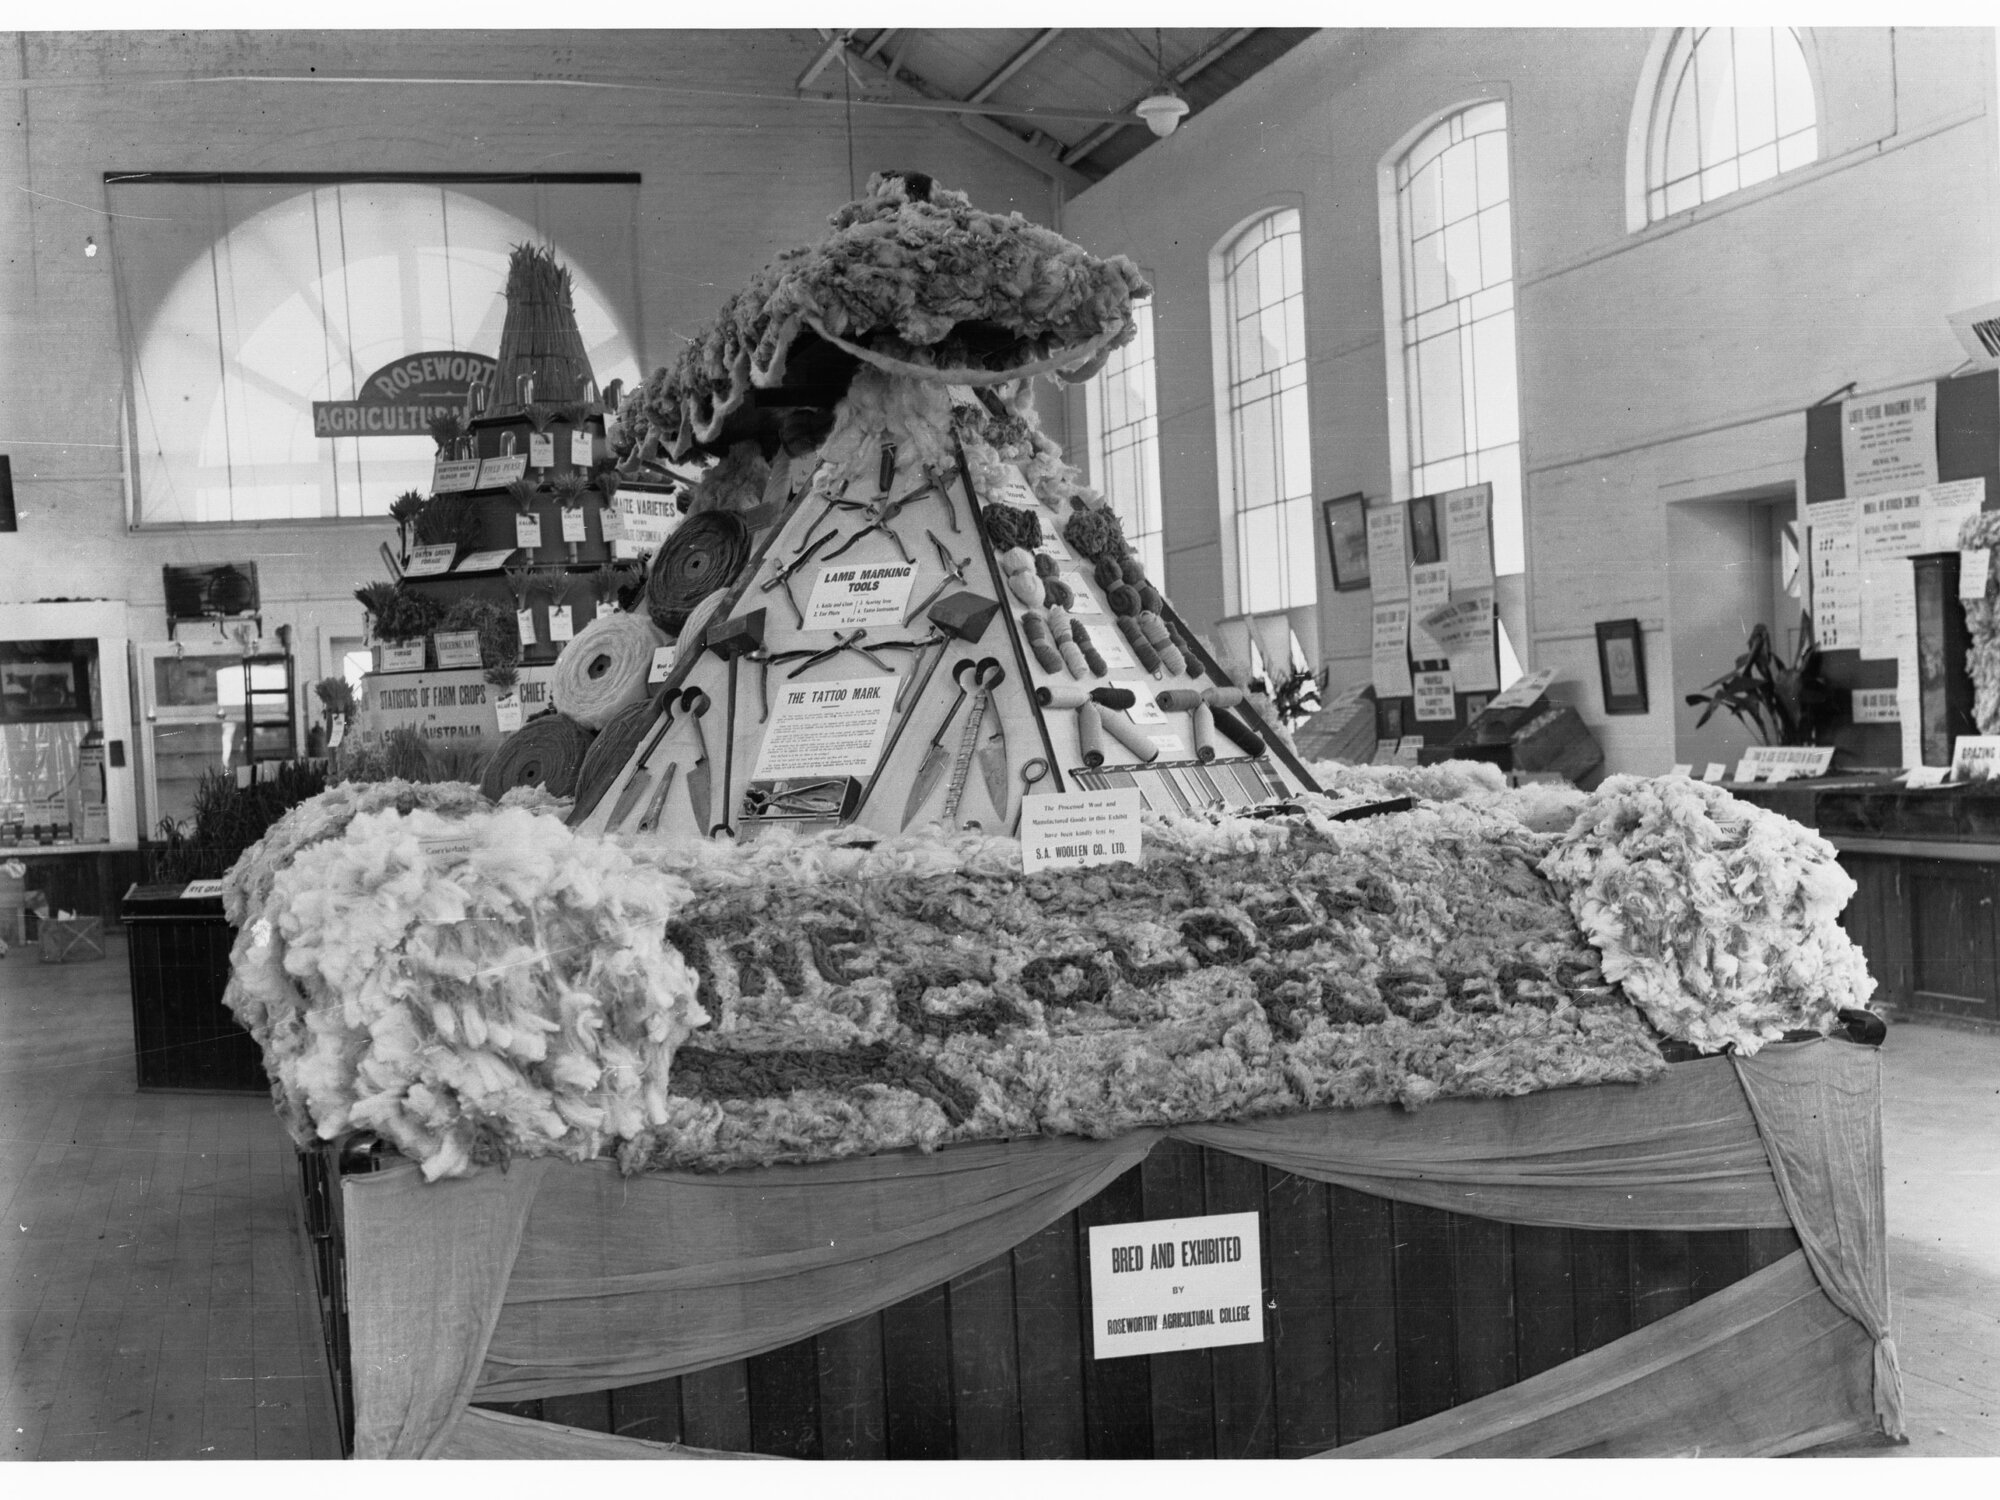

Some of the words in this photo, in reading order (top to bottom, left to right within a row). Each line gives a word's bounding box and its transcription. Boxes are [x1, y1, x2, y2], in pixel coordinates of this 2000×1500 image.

[375, 356, 499, 400] ROSEWORT
[315, 406, 470, 432] AGRICULTUR
[637, 499, 676, 517] VARIETIES
[824, 571, 856, 583] LAMB
[860, 567, 911, 580] MARKING
[848, 581, 880, 592] TOOLS
[380, 688, 418, 710] STATISTICS
[420, 687, 430, 708] OF
[433, 685, 456, 707] FARM
[459, 684, 487, 706] CROPS
[520, 682, 547, 704] CHIEF
[788, 691, 806, 704] THE
[812, 689, 848, 703] TATTOO
[852, 686, 881, 700] MARK.
[1036, 847, 1051, 860] S.A.
[1056, 844, 1088, 858] WOOLLEN
[1112, 842, 1127, 855] LTD.
[1112, 1245, 1143, 1274] BRED
[1150, 1242, 1175, 1270] AND
[1181, 1236, 1241, 1267] EXHIBITED
[1172, 1286, 1185, 1295] BY
[1107, 1315, 1158, 1335] ROSEWORTHY
[1162, 1309, 1215, 1330] AGRICULTURAL
[1220, 1305, 1250, 1324] COLLEGE
